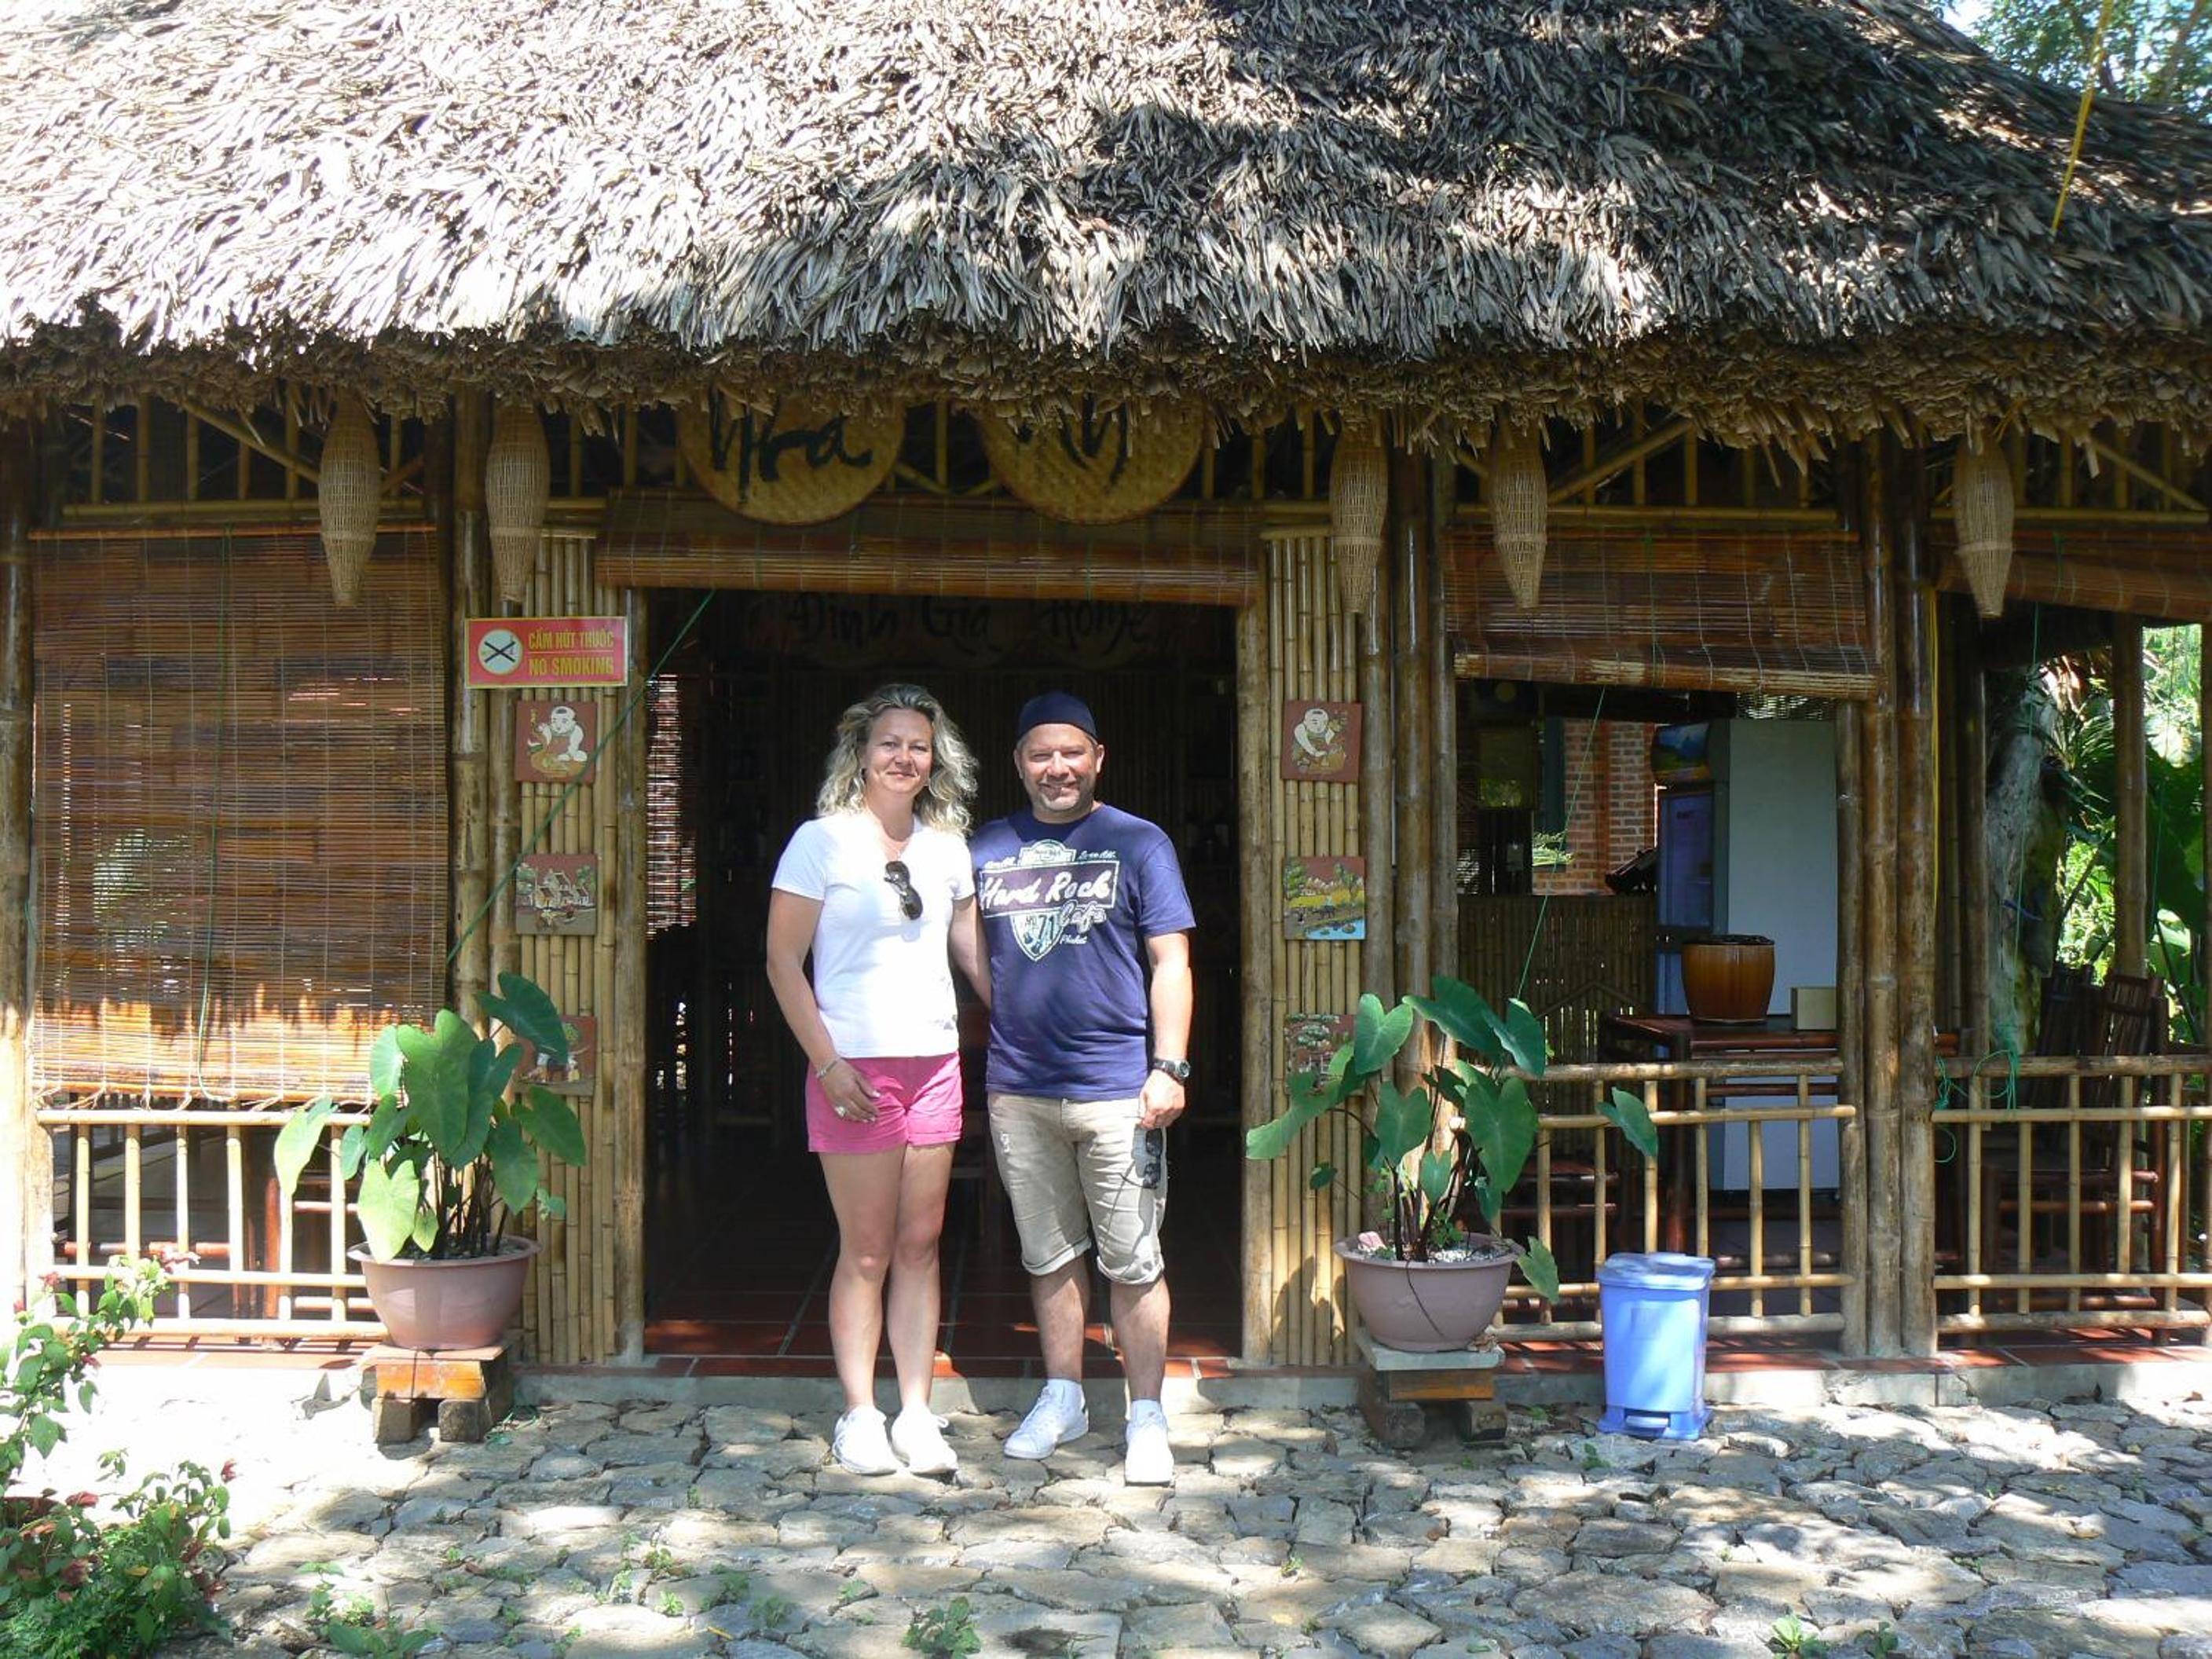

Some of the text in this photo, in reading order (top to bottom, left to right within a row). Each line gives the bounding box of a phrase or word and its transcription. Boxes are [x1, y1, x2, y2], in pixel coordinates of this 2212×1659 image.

[529, 657, 614, 676] NO SMOKING
[982, 870, 1112, 910] Hard Rock
